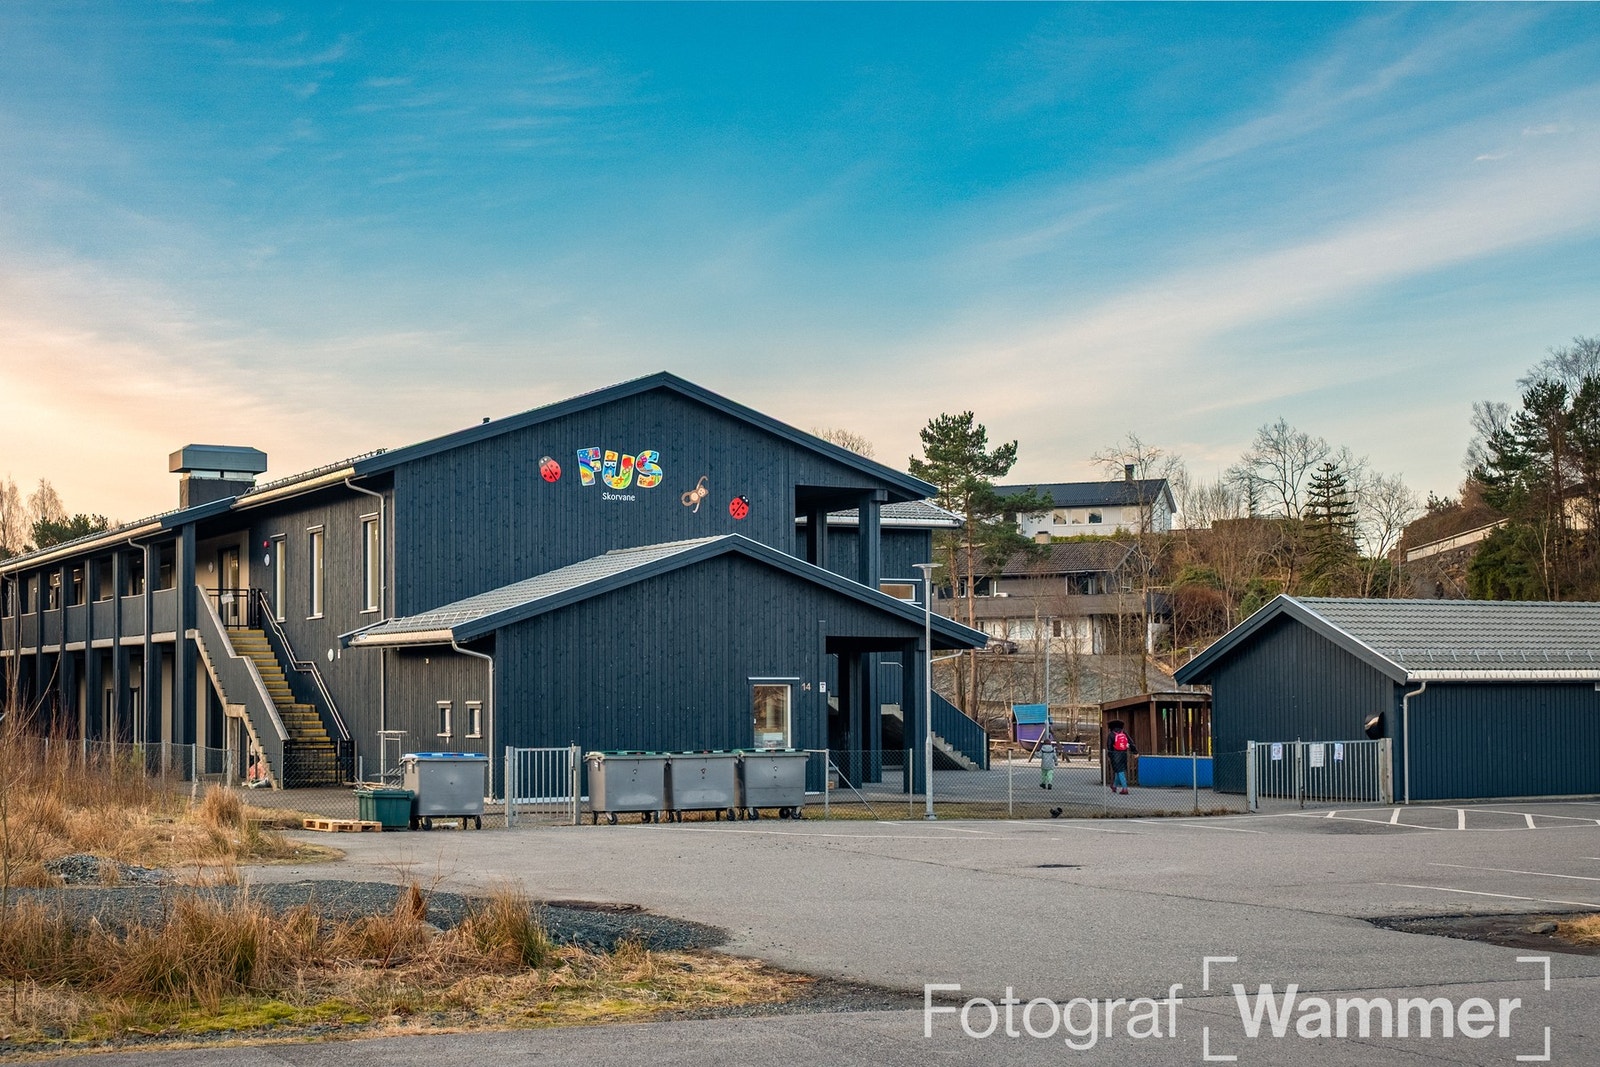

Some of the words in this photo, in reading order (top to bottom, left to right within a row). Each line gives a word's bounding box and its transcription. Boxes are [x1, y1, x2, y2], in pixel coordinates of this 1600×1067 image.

[577, 447, 663, 490] FUS
[602, 492, 636, 502] Skorvane
[801, 682, 811, 691] 14
